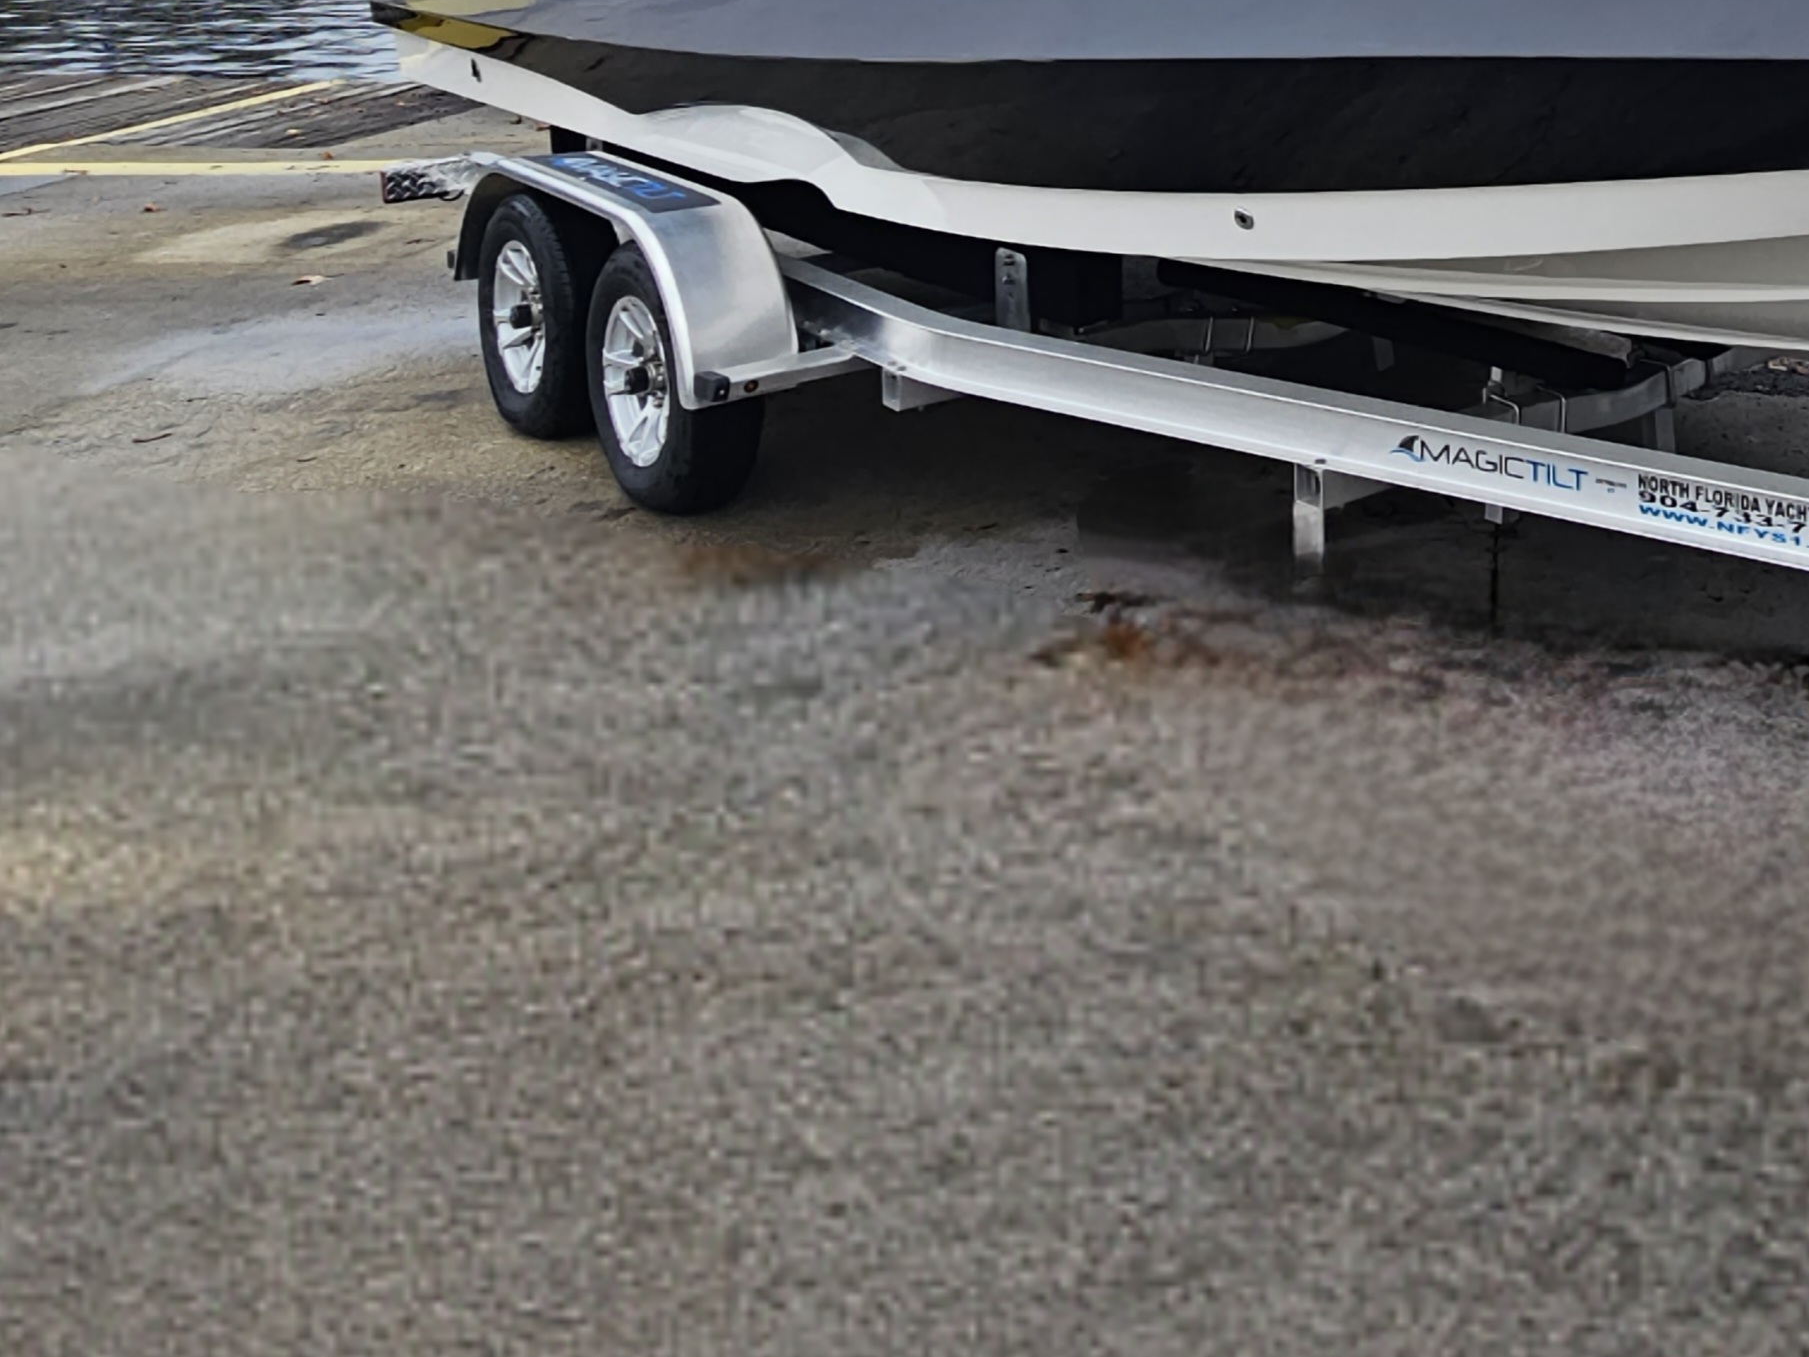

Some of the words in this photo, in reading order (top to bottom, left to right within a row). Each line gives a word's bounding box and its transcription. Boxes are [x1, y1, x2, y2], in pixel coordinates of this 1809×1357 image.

[1420, 439, 1589, 491] MAGICTILT
[1638, 473, 1690, 499] NORTH
[1695, 485, 1761, 512] FLORIDA
